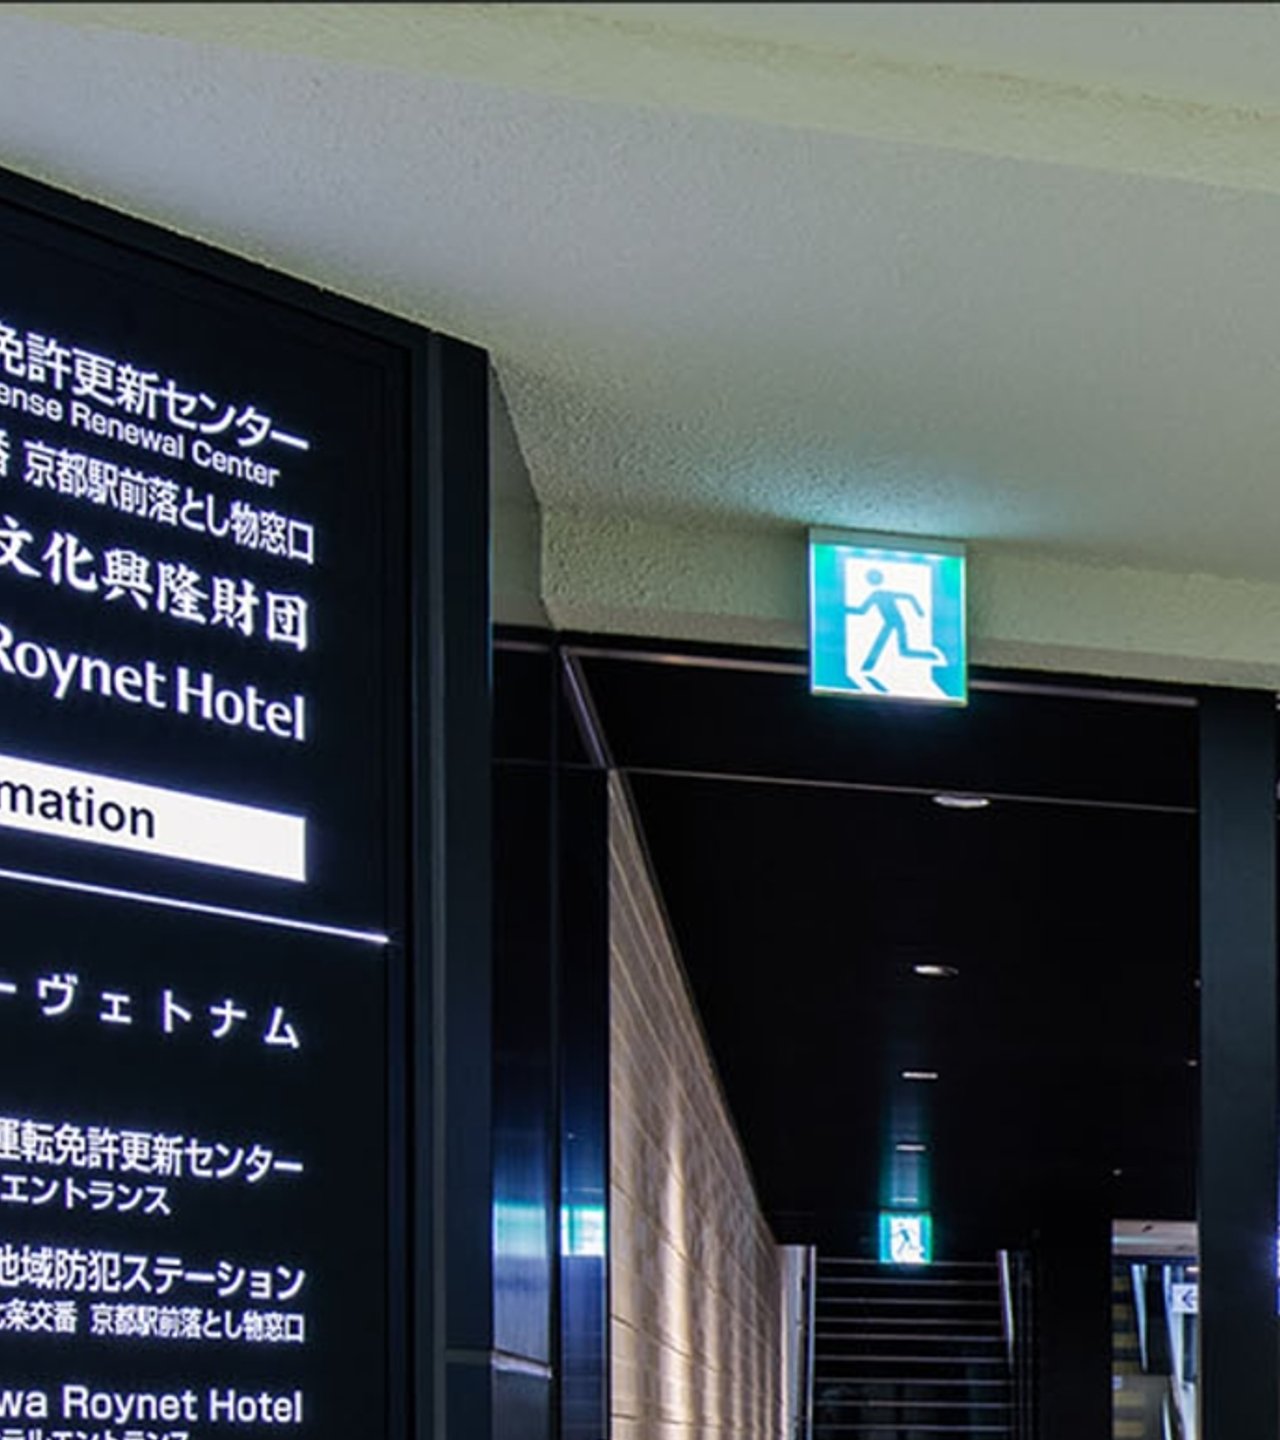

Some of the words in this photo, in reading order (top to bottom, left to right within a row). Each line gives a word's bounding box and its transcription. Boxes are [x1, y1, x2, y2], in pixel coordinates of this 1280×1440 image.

[71, 400, 185, 460] Renewal
[192, 439, 281, 488] Center
[23, 440, 315, 565] 京都駅前落とし物窓口
[0, 513, 307, 652] 文化興隆財団
[177, 666, 305, 741] Hotel
[1, 1174, 171, 1215] エントランス
[0, 1297, 77, 1334] 条交番
[90, 1303, 305, 1343] 京都駅前落とし物窓口
[62, 1385, 198, 1424] Roynet
[208, 1388, 302, 1423] Hotel
